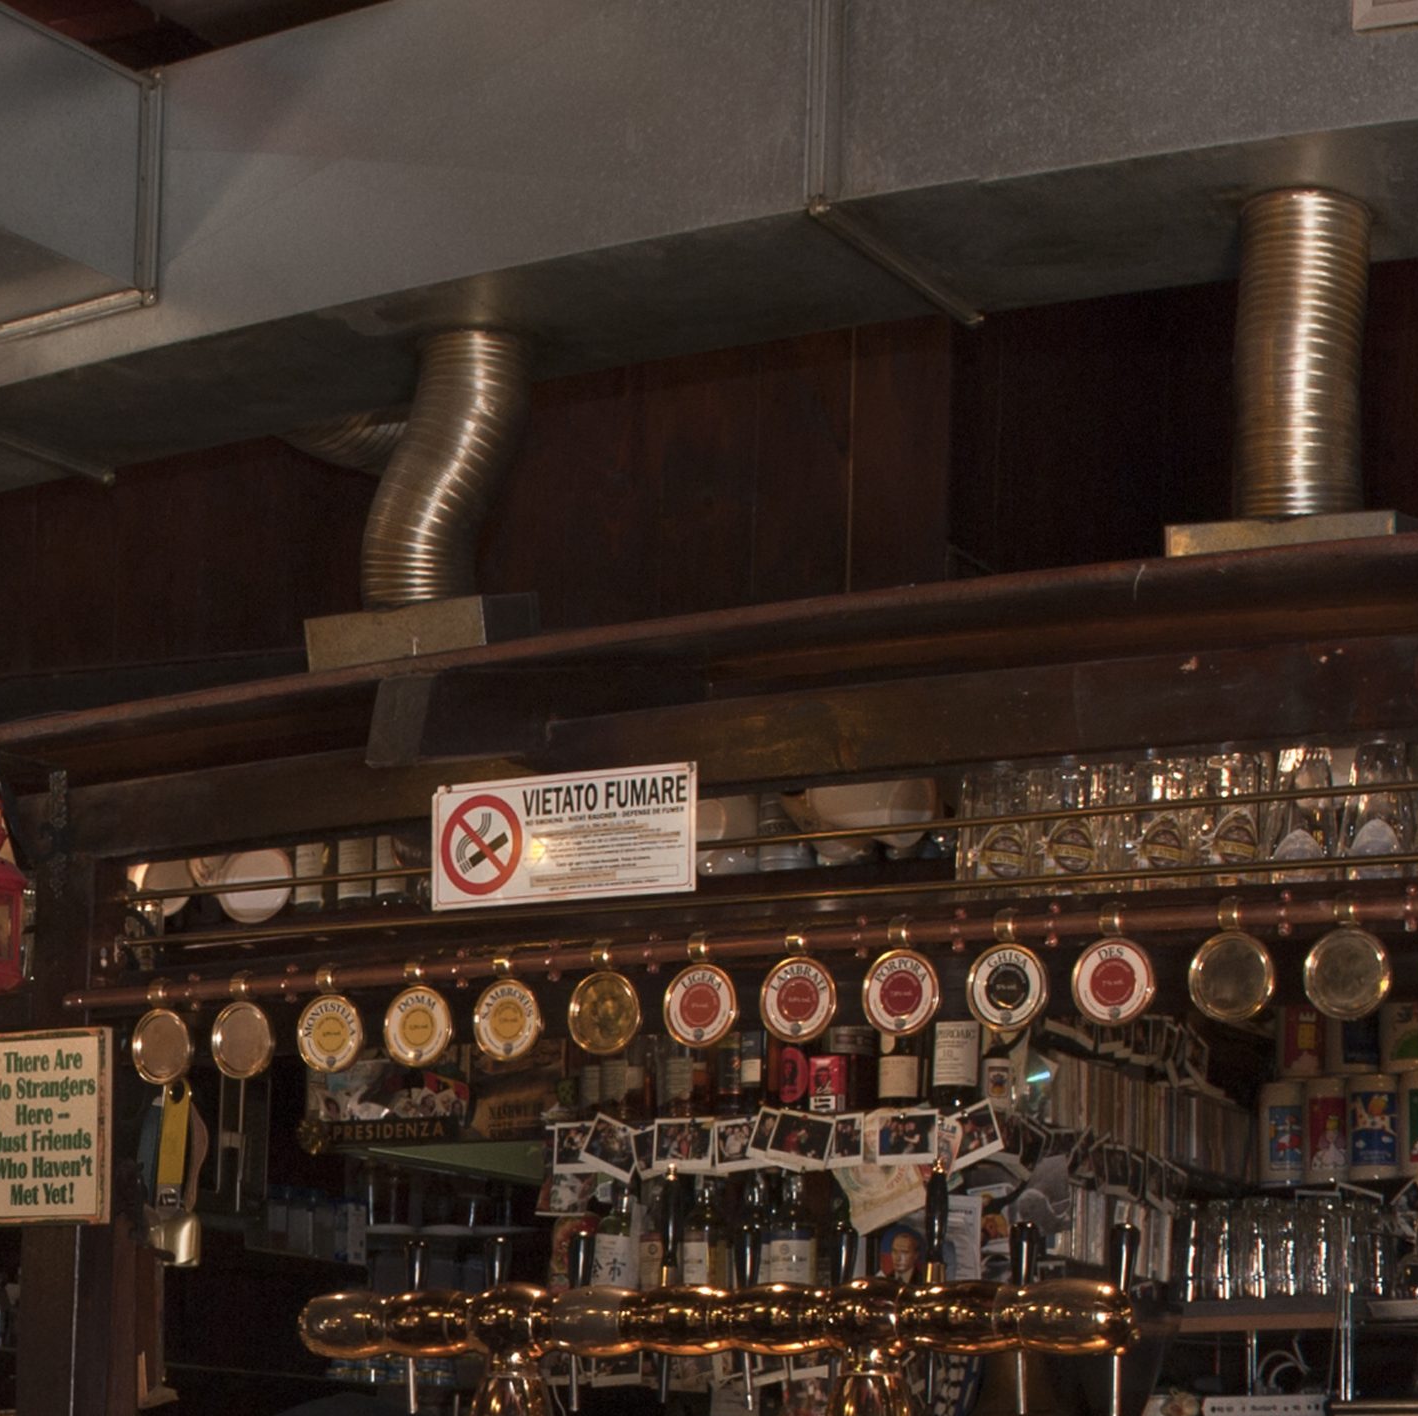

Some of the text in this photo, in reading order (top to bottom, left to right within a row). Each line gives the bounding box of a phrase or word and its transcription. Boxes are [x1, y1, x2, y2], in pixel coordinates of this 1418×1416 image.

[522, 774, 688, 817] VIETATO FUMARE
[987, 951, 1028, 970] GHISA
[1097, 947, 1124, 961] DES
[681, 971, 722, 991] LIGERA
[770, 964, 828, 994] LAMBRATE
[874, 958, 927, 984] PORPORA
[398, 994, 437, 1014] DOMM
[303, 1001, 357, 1039] MONTESTELLA
[4, 1049, 83, 1074] There Are
[16, 1076, 96, 1102] Strangers
[16, 1104, 53, 1126] Here
[32, 1129, 92, 1151] Friends
[333, 1121, 445, 1142] PRESIDENZA
[32, 1155, 93, 1179] Haven't
[10, 1182, 75, 1206] Met Yet!
